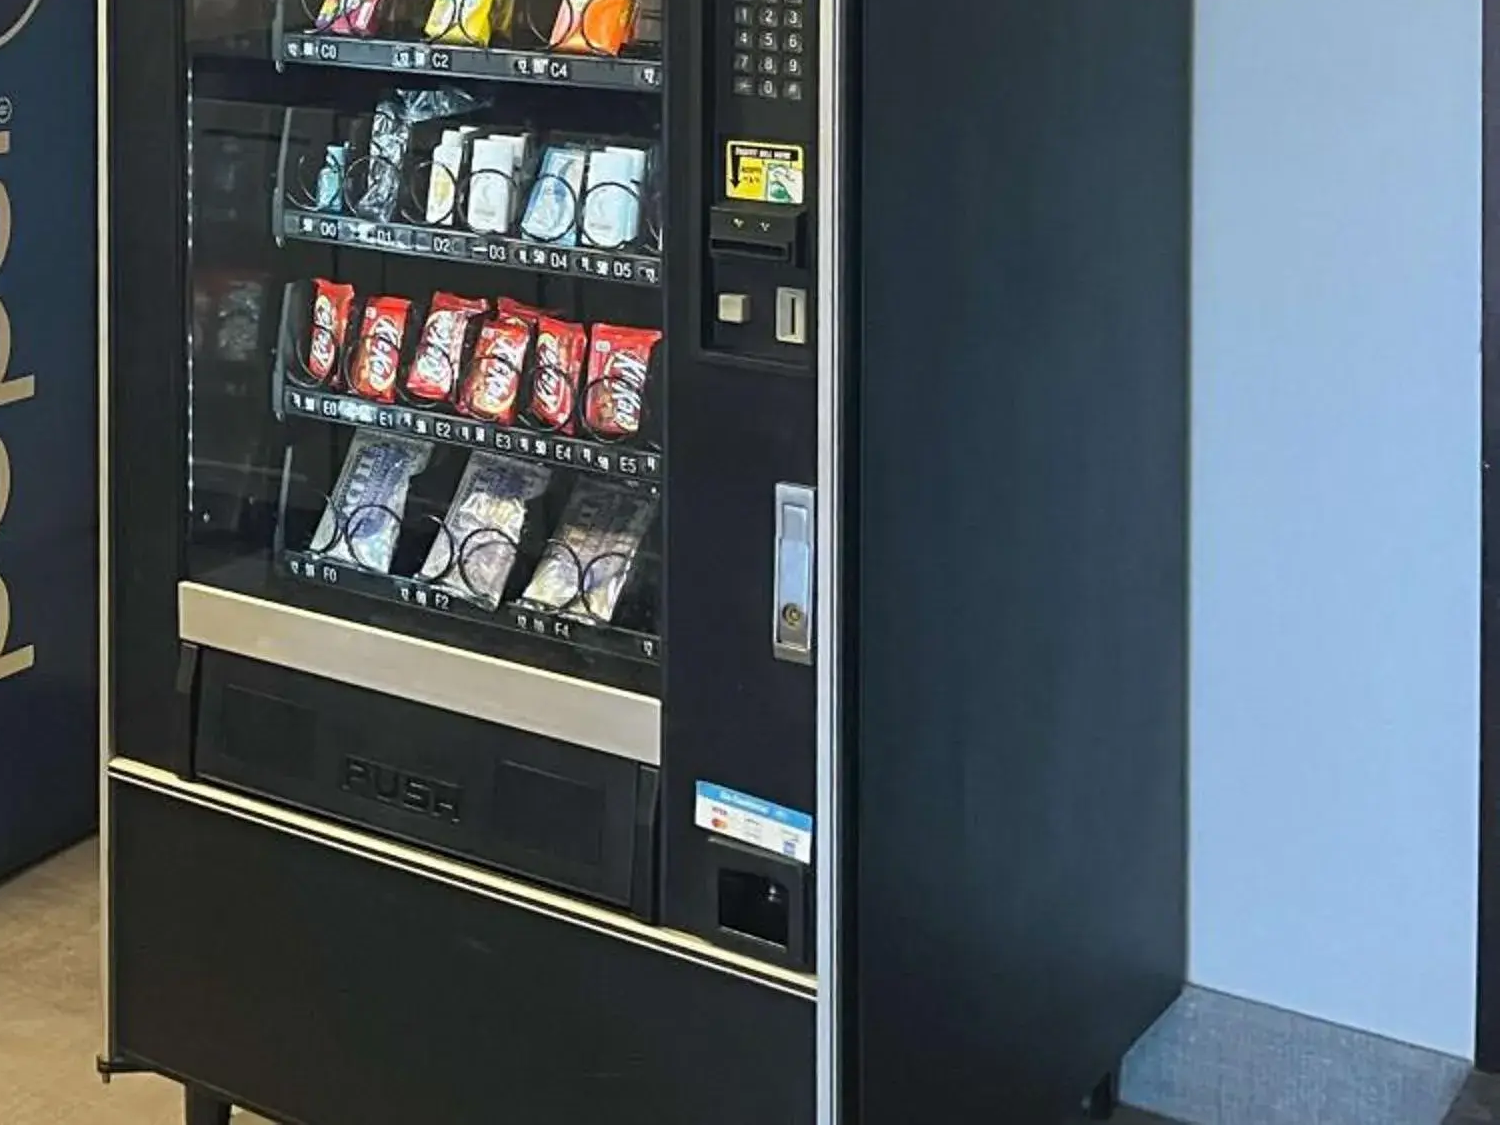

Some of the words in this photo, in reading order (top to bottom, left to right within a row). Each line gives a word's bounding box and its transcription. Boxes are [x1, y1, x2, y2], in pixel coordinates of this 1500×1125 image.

[432, 52, 449, 68] C2
[550, 62, 568, 78] C4
[379, 409, 393, 427] E1
[435, 420, 451, 437] E2
[495, 432, 511, 450] E3
[555, 443, 571, 461] E4
[618, 456, 637, 474] E5
[323, 565, 337, 584] F0
[435, 591, 450, 610] F2
[341, 755, 463, 824] PUSH
